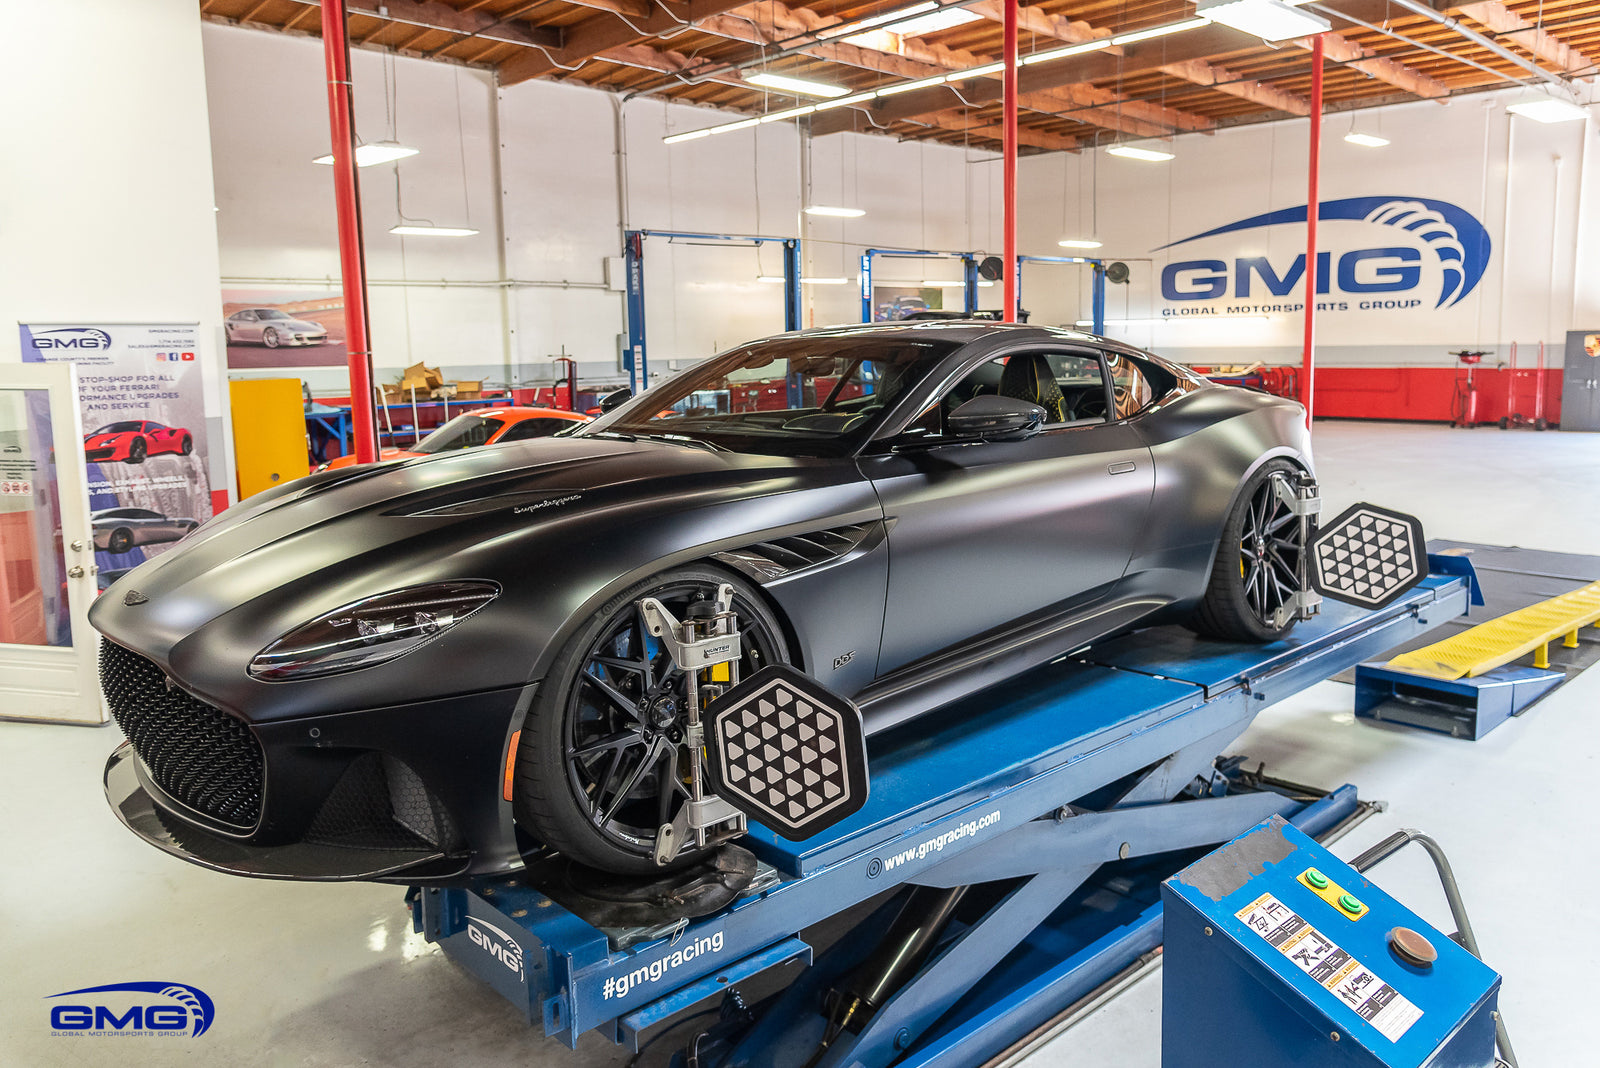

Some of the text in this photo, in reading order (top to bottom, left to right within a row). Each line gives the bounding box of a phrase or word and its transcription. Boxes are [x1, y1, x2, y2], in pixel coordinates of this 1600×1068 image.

[1161, 247, 1421, 301] GMG
[1162, 299, 1421, 316] GLOBAL MOTORSPRTS GROUP
[32, 338, 99, 349] GMG
[87, 403, 108, 411] AND
[884, 810, 1001, 871] www.gmgracing.com
[467, 924, 519, 973] GMG
[603, 931, 724, 1000] #gmgracing
